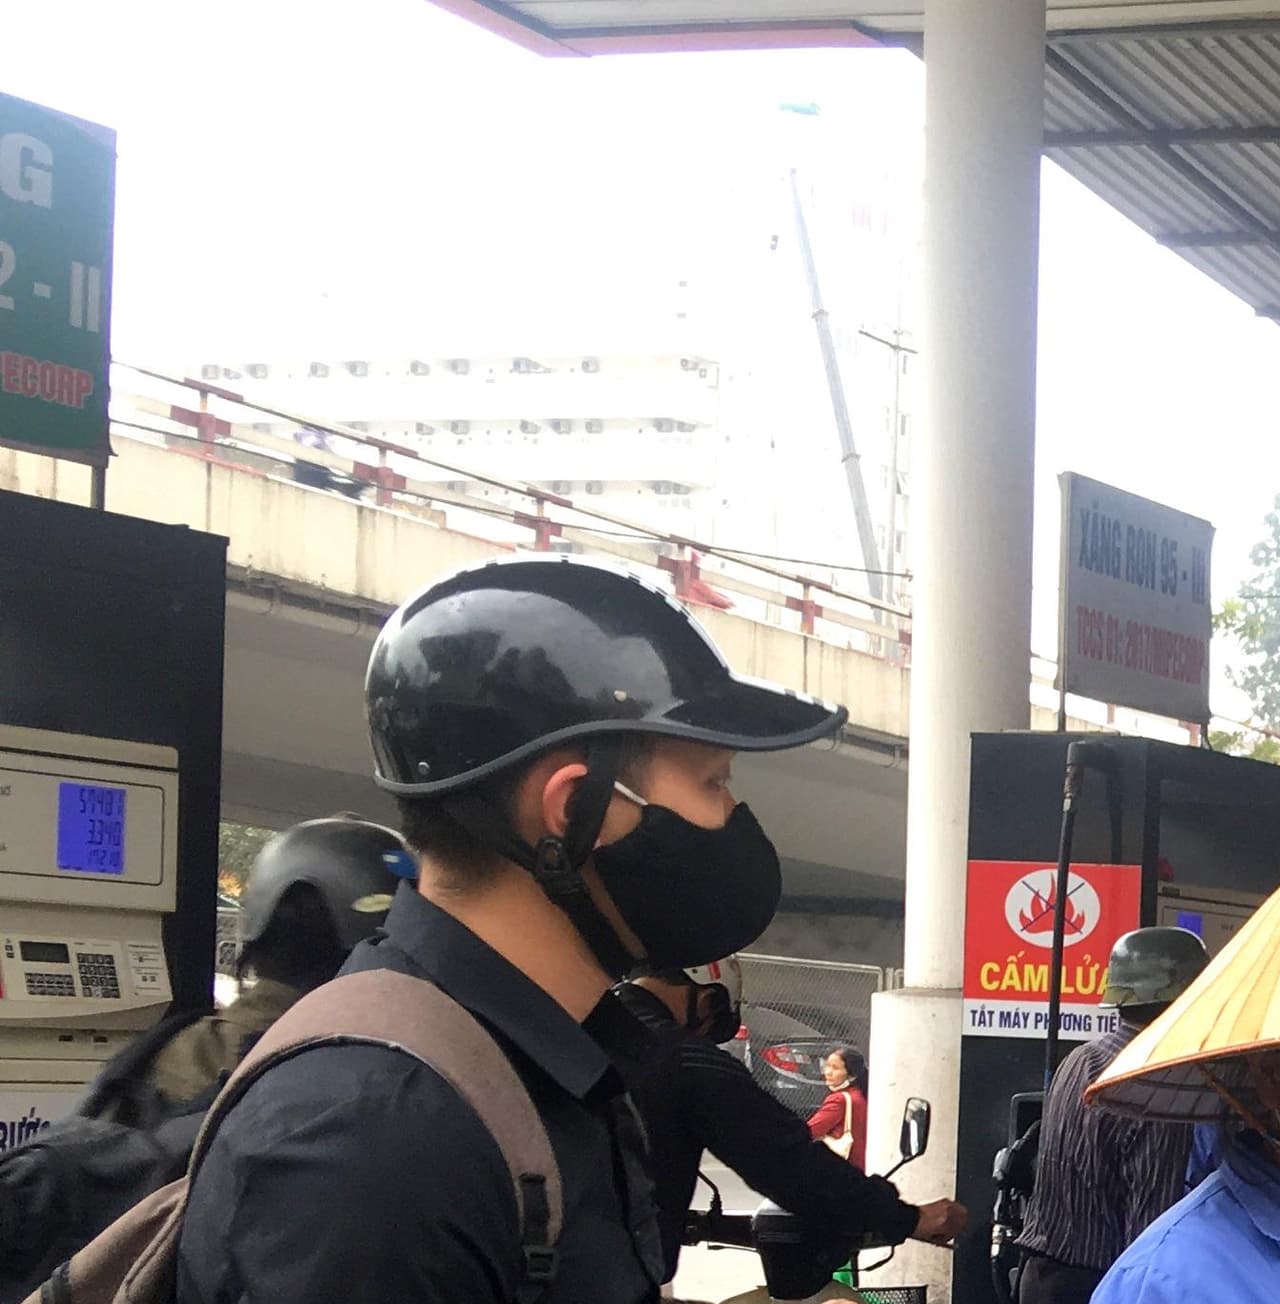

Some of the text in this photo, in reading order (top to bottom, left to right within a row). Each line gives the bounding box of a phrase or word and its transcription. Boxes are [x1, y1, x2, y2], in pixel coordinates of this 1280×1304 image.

[0, 352, 94, 409] ECORP
[980, 951, 1049, 992] CẤM
[970, 1004, 994, 1028] TẮT
[1000, 1008, 1030, 1030] MÁY
